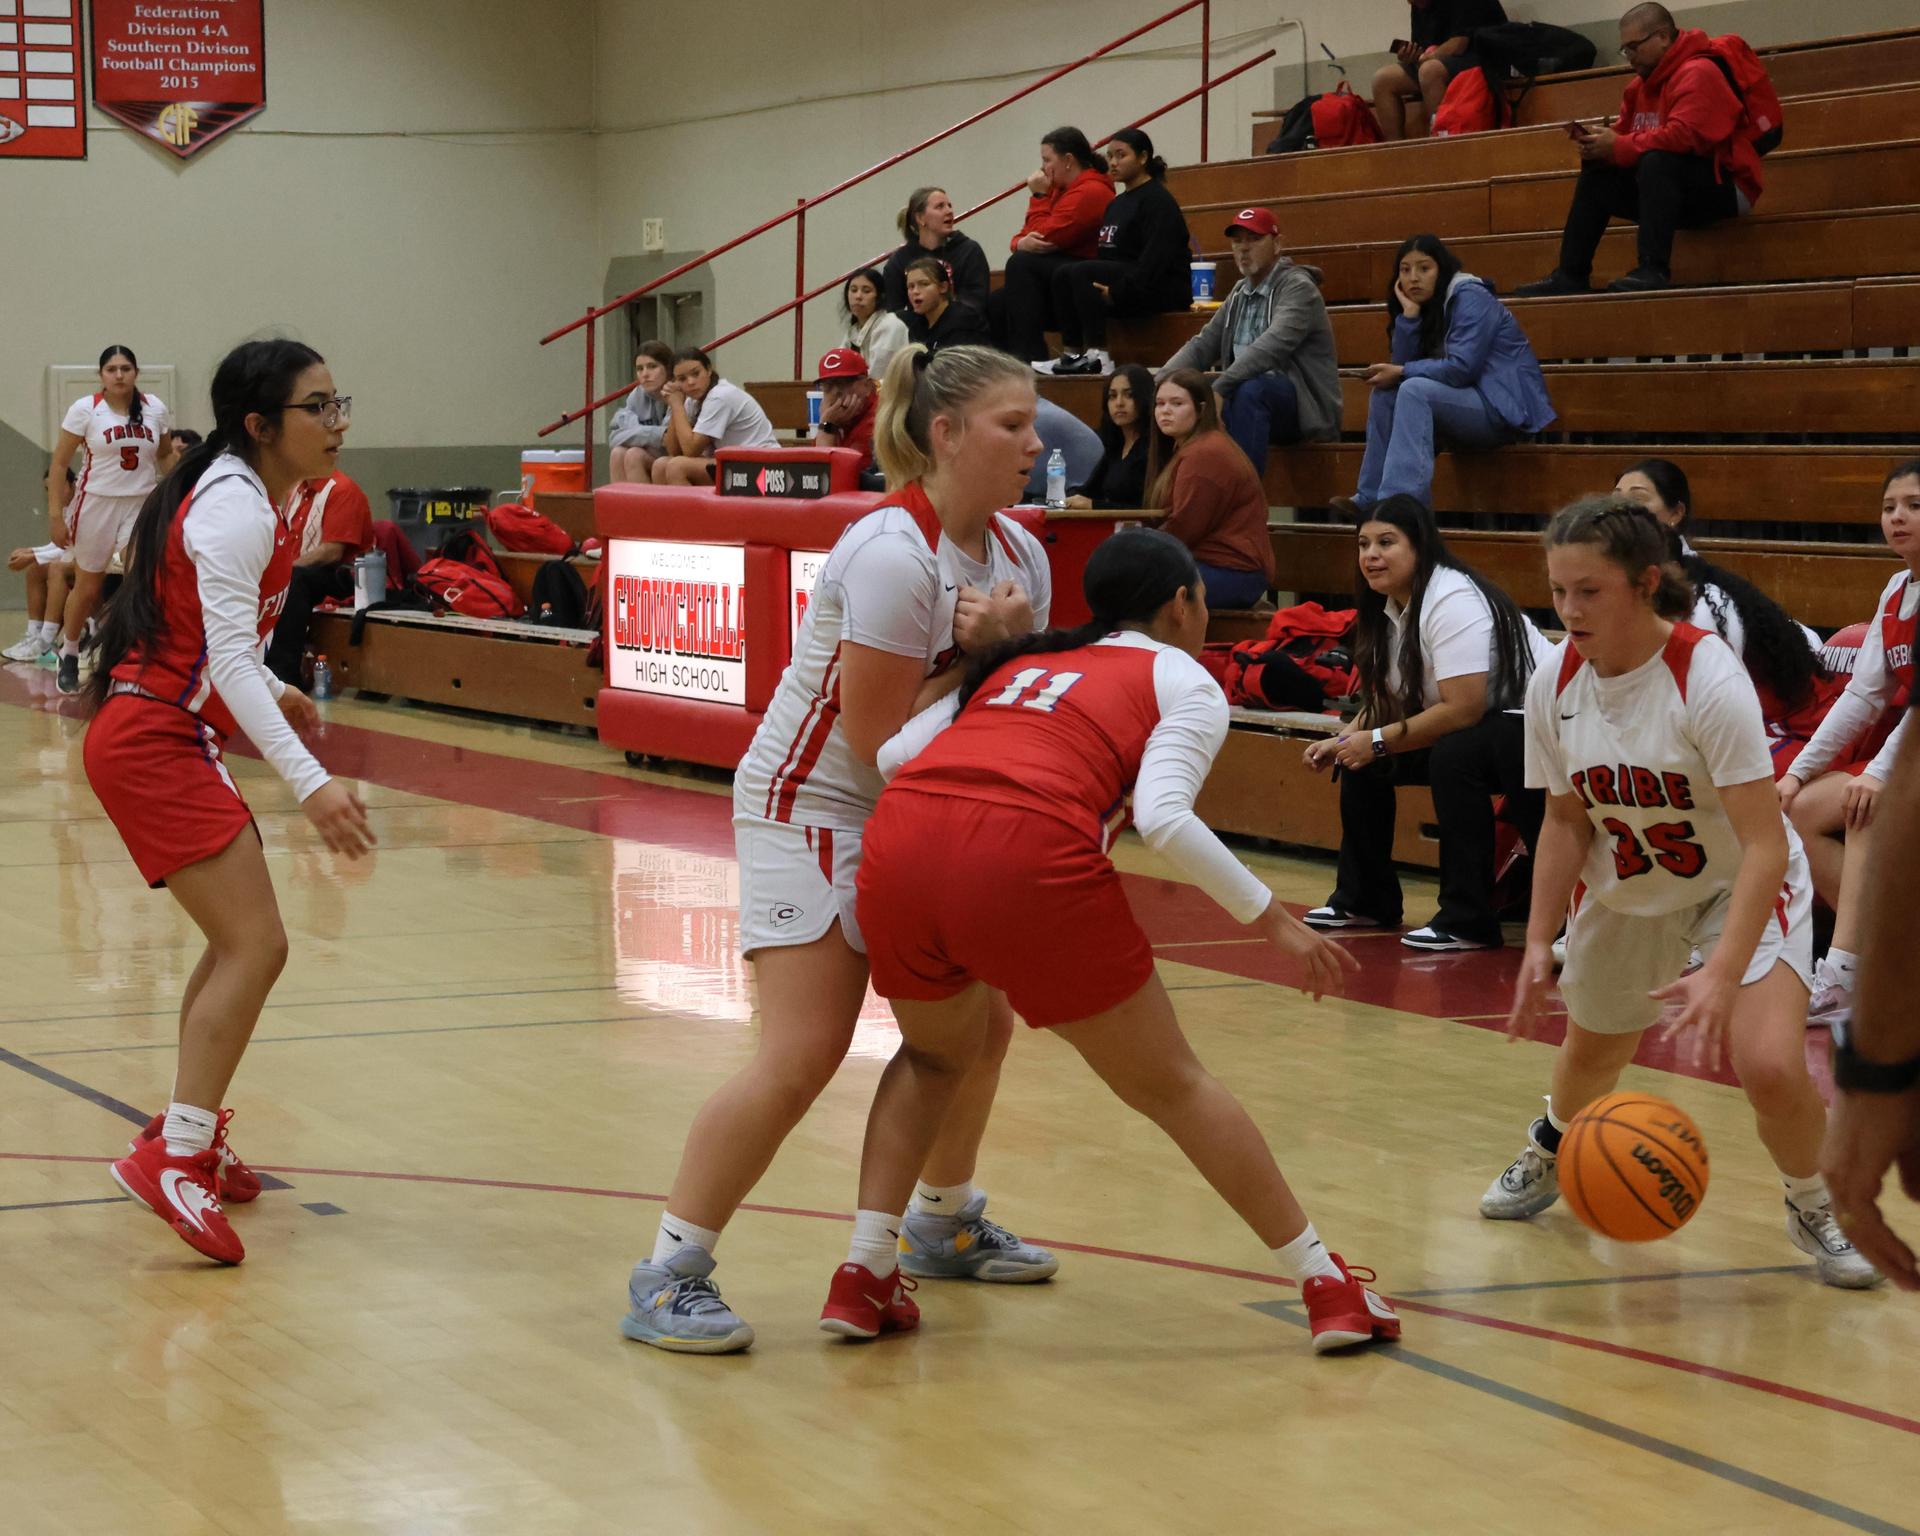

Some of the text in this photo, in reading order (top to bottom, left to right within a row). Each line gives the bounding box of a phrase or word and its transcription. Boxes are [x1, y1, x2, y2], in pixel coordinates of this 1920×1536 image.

[135, 5, 220, 19] Federation
[127, 22, 229, 37] Division 4-A
[107, 39, 249, 55] Southern Divison
[102, 57, 256, 75] Football Champions
[160, 76, 199, 89] 2015
[158, 103, 198, 145] CIF
[1239, 209, 1255, 219] C
[823, 354, 841, 369] C
[103, 424, 155, 444] TRIBE
[120, 446, 139, 471] 5
[765, 469, 785, 493] POSS
[802, 475, 819, 490] BONUS
[635, 660, 729, 692] HIGH SCHOOL
[985, 667, 1085, 713] 11
[1570, 763, 1695, 810] TRIBE
[777, 908, 794, 919] C
[1631, 1143, 1697, 1220] Wilson
